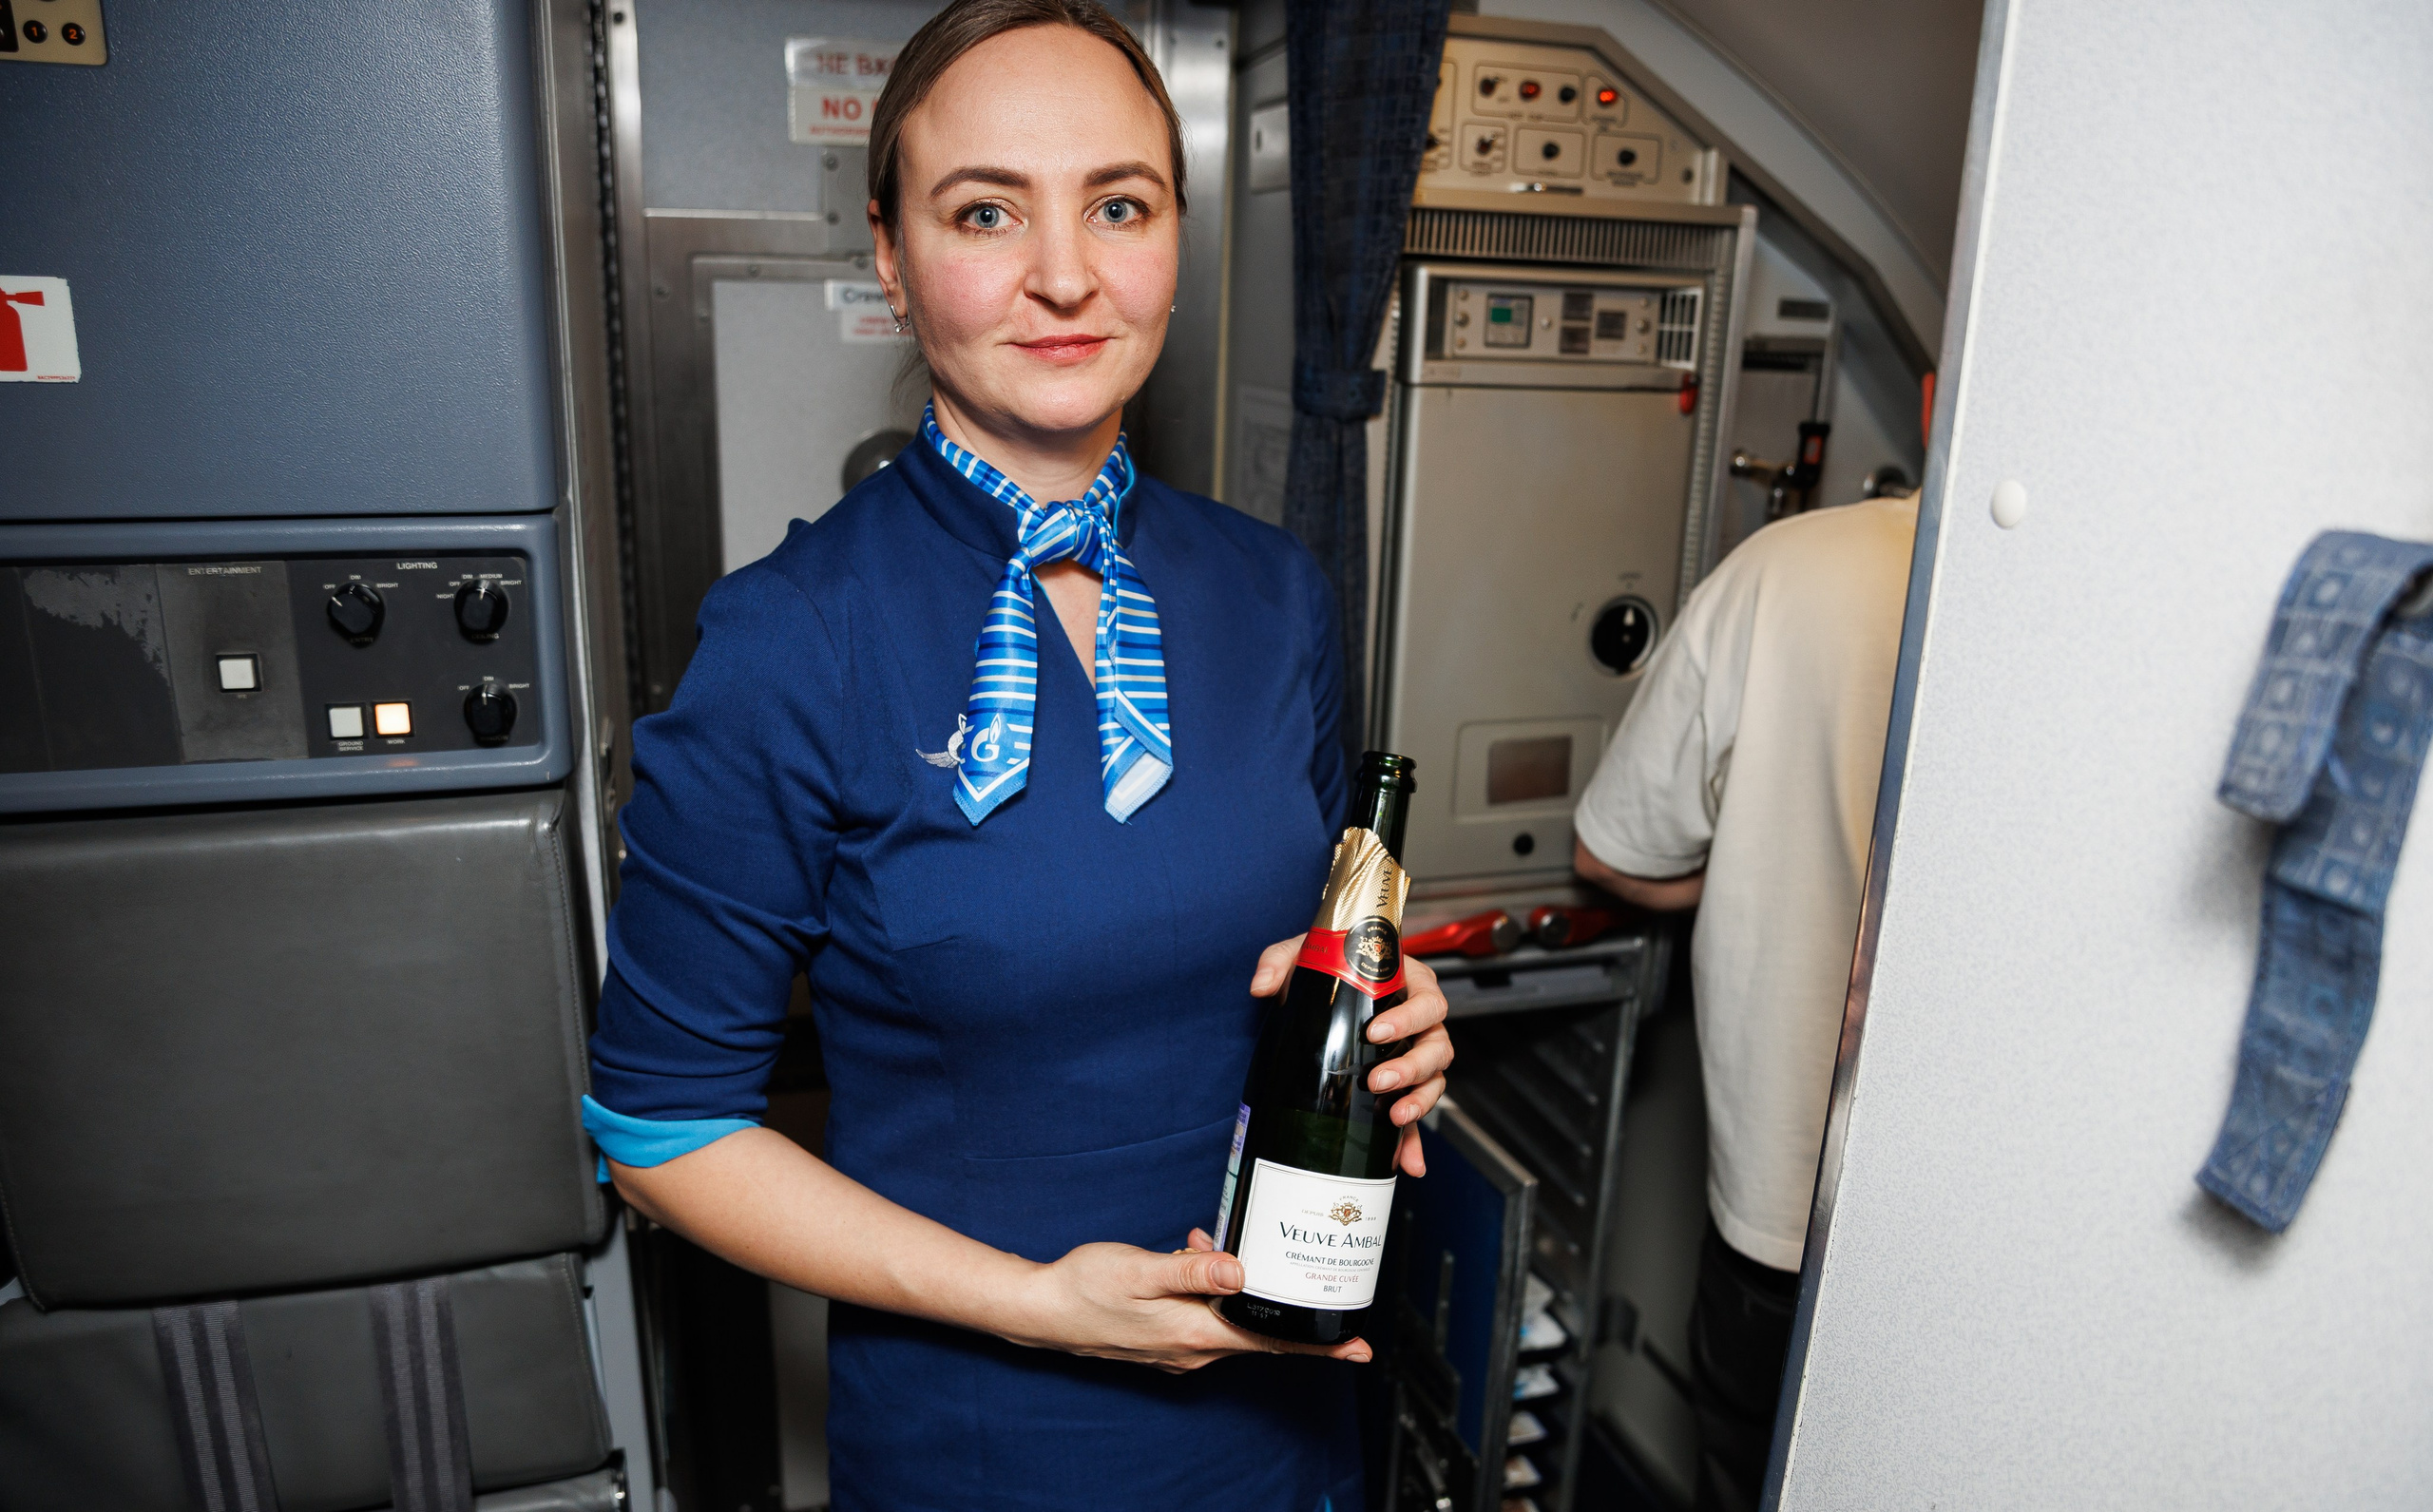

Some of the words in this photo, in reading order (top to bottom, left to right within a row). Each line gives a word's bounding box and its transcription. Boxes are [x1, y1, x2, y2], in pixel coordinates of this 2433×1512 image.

[31, 27, 38, 37] 1
[68, 29, 78, 40] 2
[821, 96, 862, 122] NO
[188, 566, 262, 576] ENTERTAINMENT
[396, 562, 438, 570] LIGHTING
[1377, 866, 1393, 908] VEUVE
[1279, 1221, 1338, 1248] VEUVE
[1340, 1233, 1383, 1249] AMBAL
[1285, 1250, 1327, 1265] CRÉMANT
[1327, 1256, 1338, 1266] DE
[1338, 1257, 1375, 1268] BOURGOGNE
[1305, 1272, 1338, 1283] GRANDE
[1338, 1273, 1360, 1283] CUVÉE
[1323, 1284, 1343, 1293] BRUT
